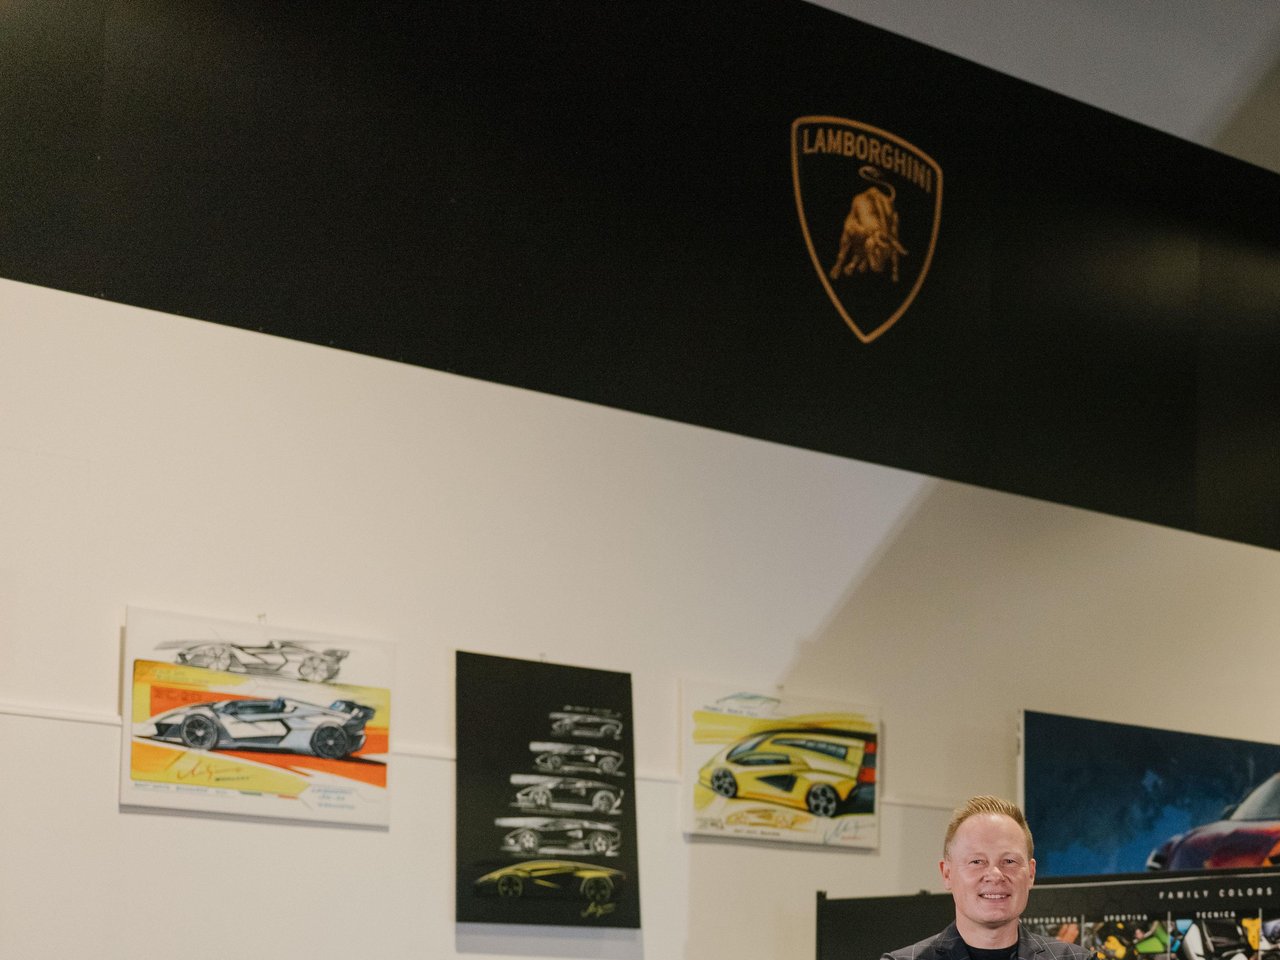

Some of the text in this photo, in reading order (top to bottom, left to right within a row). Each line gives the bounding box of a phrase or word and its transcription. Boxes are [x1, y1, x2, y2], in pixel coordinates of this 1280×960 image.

[802, 127, 932, 193] LAMBORGHINI
[1159, 887, 1272, 899] FAMILY COLORS
[1104, 914, 1148, 922] SPORTIVA
[1196, 911, 1236, 919] TECNICA
